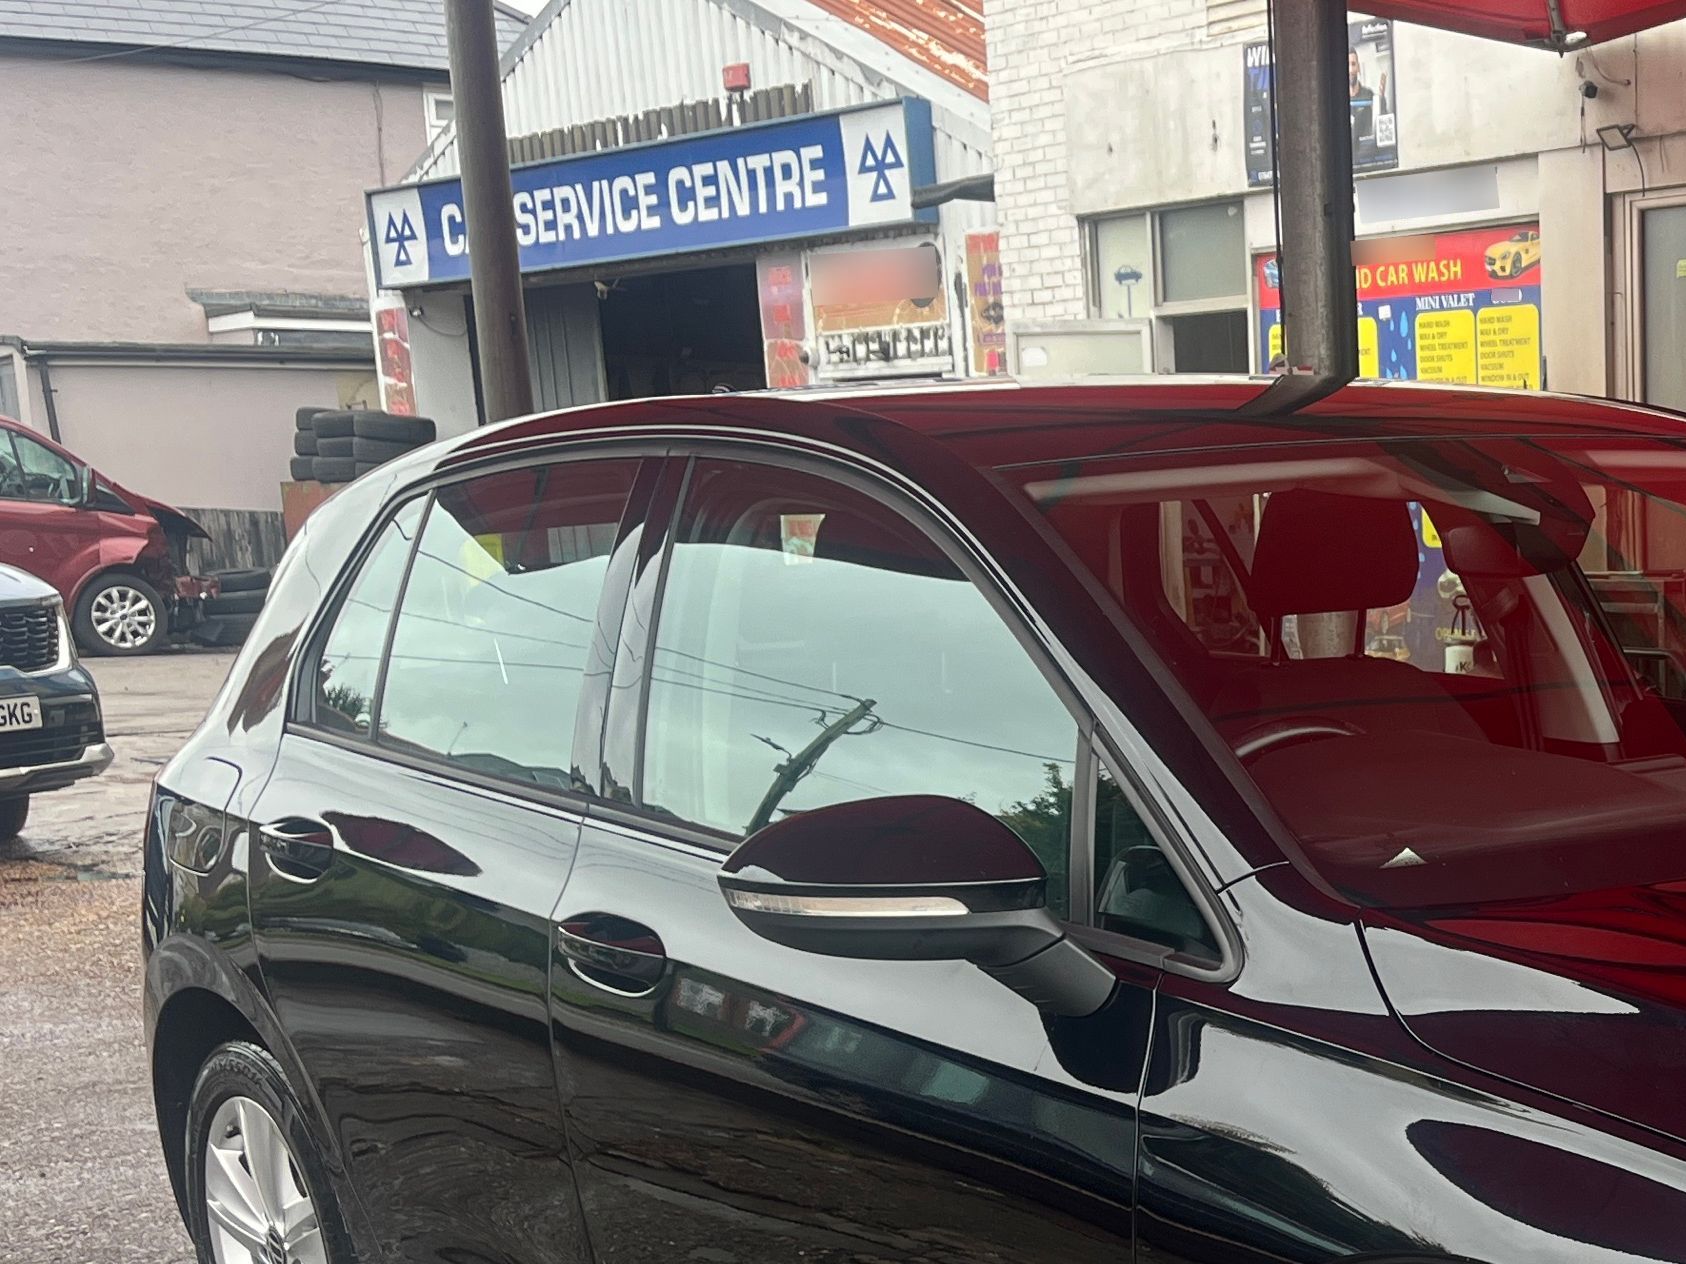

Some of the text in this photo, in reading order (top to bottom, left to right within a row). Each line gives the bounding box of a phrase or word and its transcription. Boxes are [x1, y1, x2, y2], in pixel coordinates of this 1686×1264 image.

[512, 171, 661, 246] SERVICE
[667, 144, 828, 226] CENTRE
[1376, 264, 1408, 287] CAR
[1412, 259, 1462, 283] WASH
[1415, 295, 1440, 311] MINI
[1441, 293, 1476, 308] VALET
